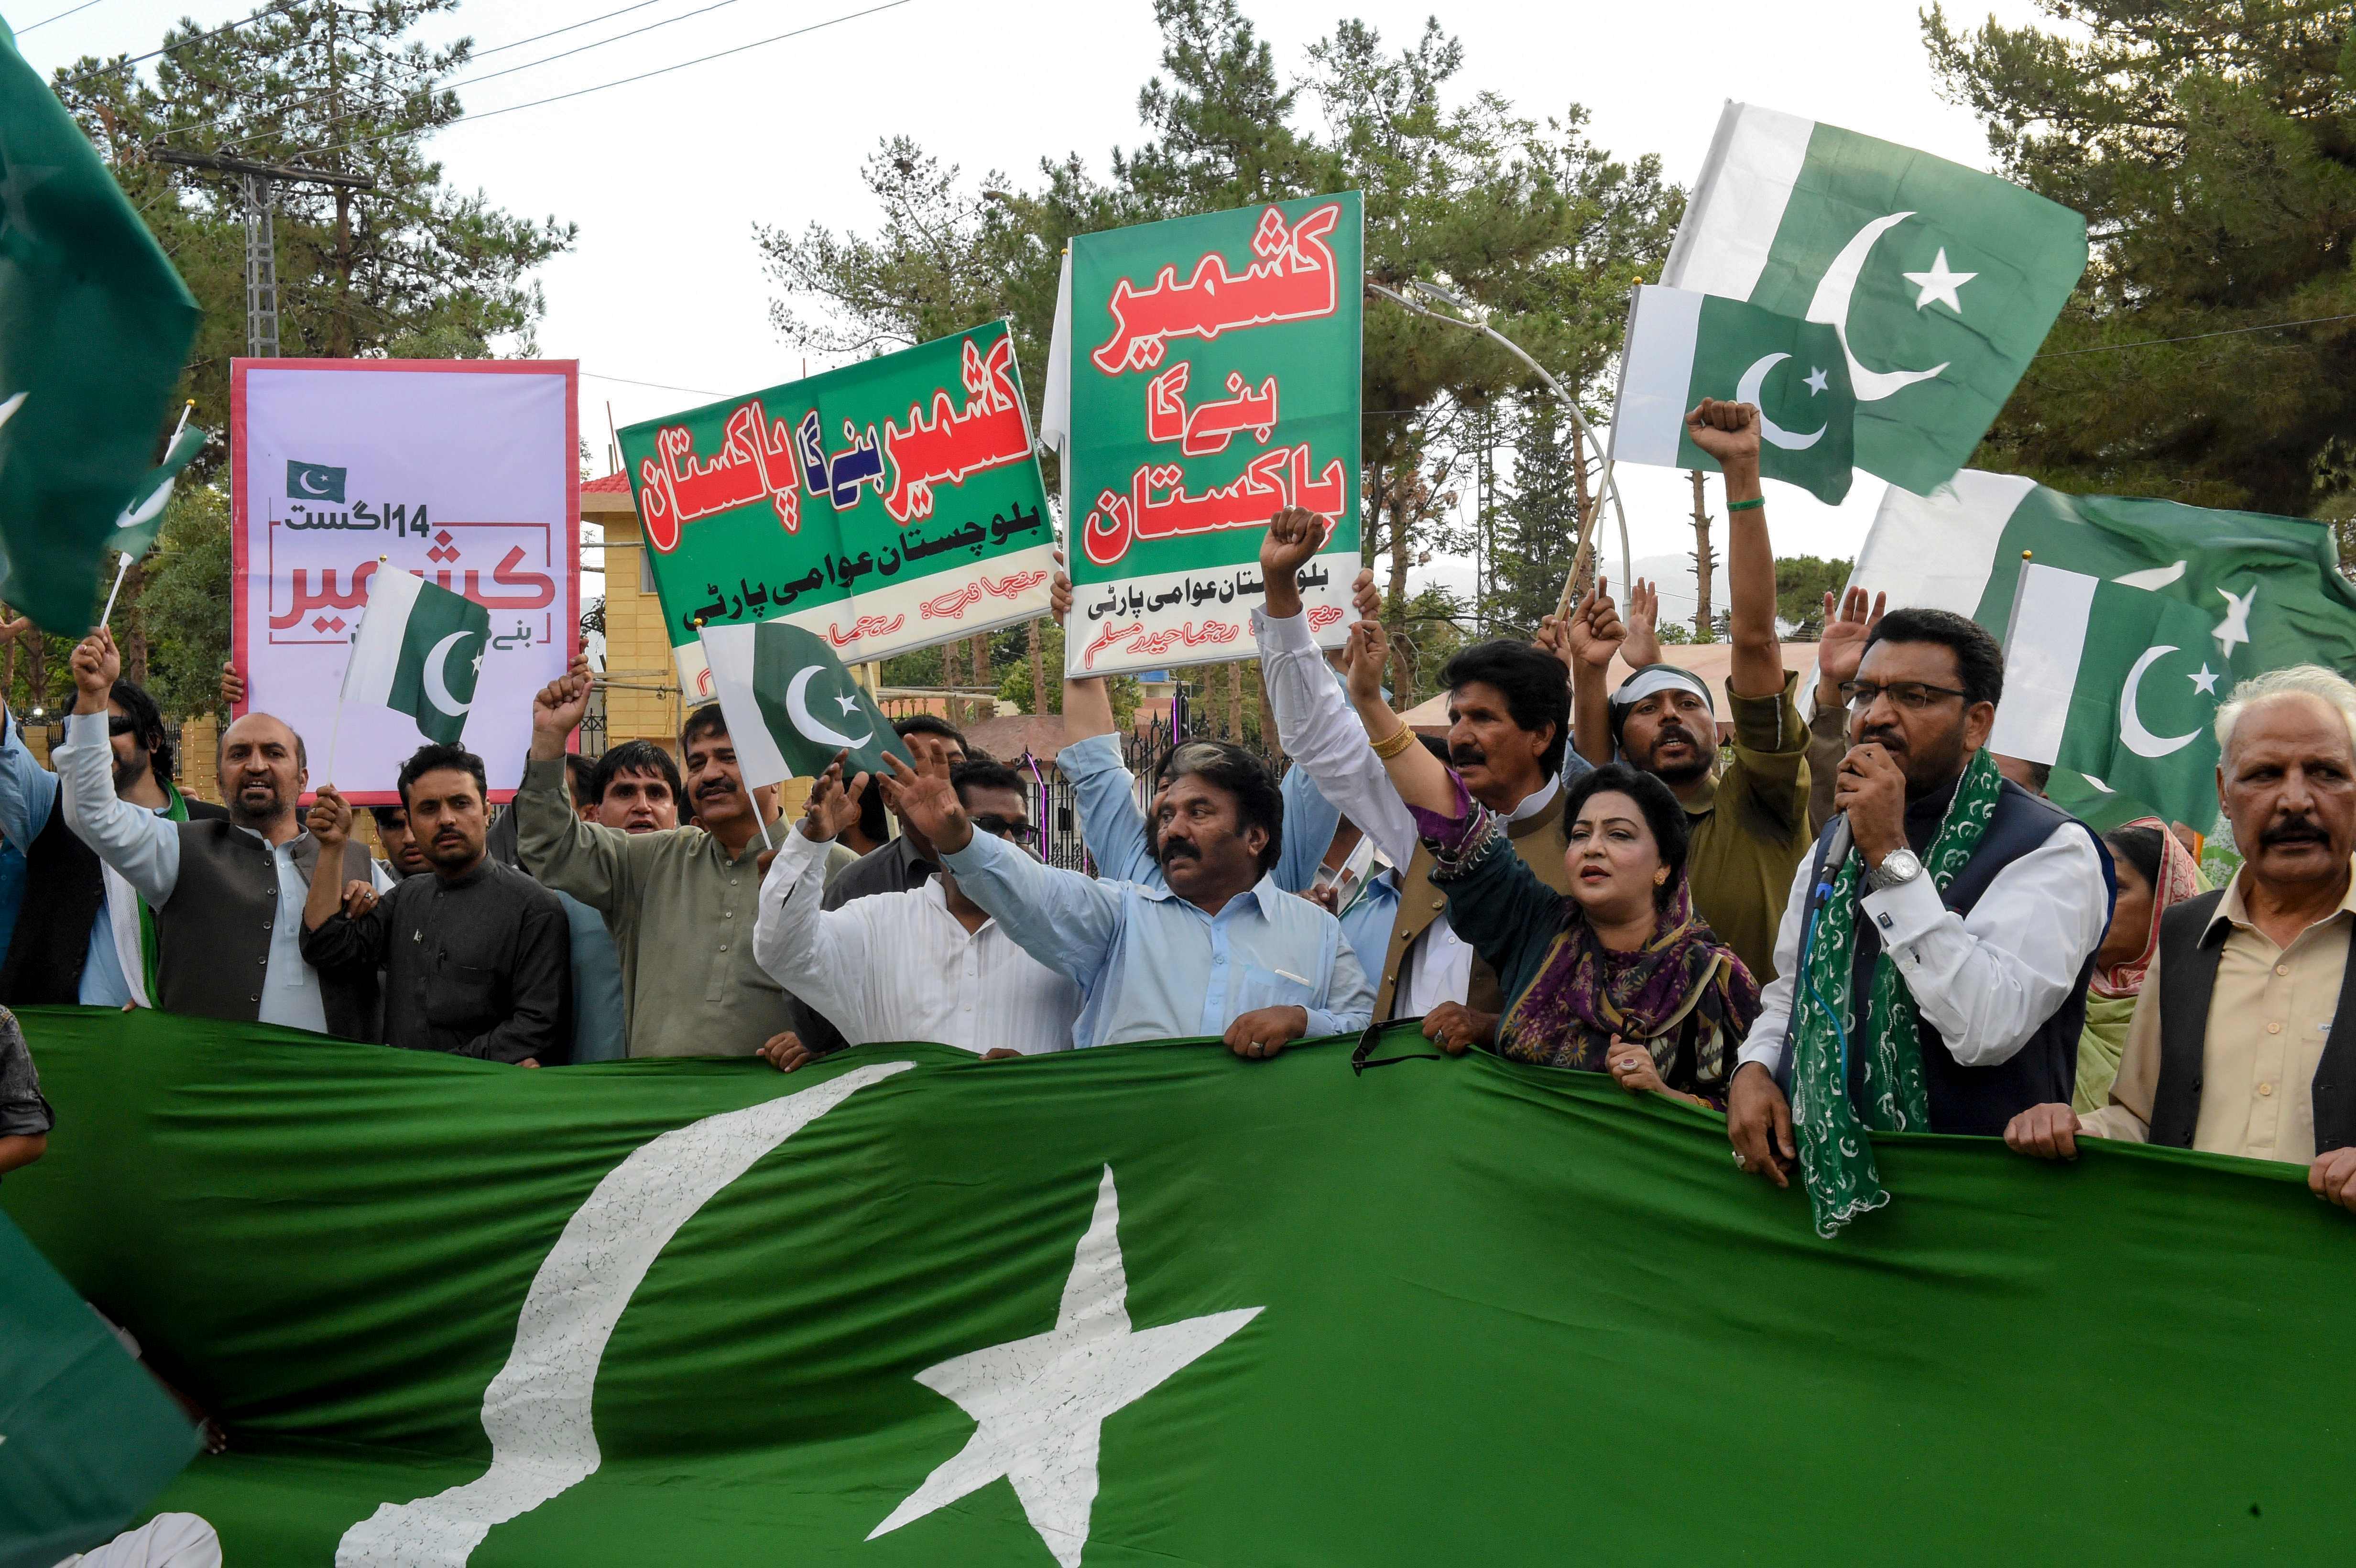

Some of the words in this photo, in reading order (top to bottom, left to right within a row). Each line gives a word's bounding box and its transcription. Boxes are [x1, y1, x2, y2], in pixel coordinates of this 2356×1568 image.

[1093, 205, 1339, 373] کشمیر
[1148, 362, 1189, 442] گا
[1182, 372, 1277, 456] بنے
[797, 410, 831, 496] گا
[885, 337, 1032, 522] کشمیر
[642, 401, 799, 551] پاکستان
[829, 420, 885, 510] بنے
[284, 500, 391, 531] اگست
[394, 504, 430, 538] 14
[1083, 444, 1344, 565] پاکستان
[877, 501, 1041, 576] بلوچستان
[683, 578, 768, 632] پارٹی
[772, 553, 873, 606] عوامی
[1088, 584, 1144, 620] پارٹی
[1147, 577, 1217, 612] عوامی
[1218, 562, 1329, 603] بلوتان
[492, 620, 532, 651] بنے
[1084, 621, 1144, 669] مسلم
[1127, 629, 1185, 654] حیدر
